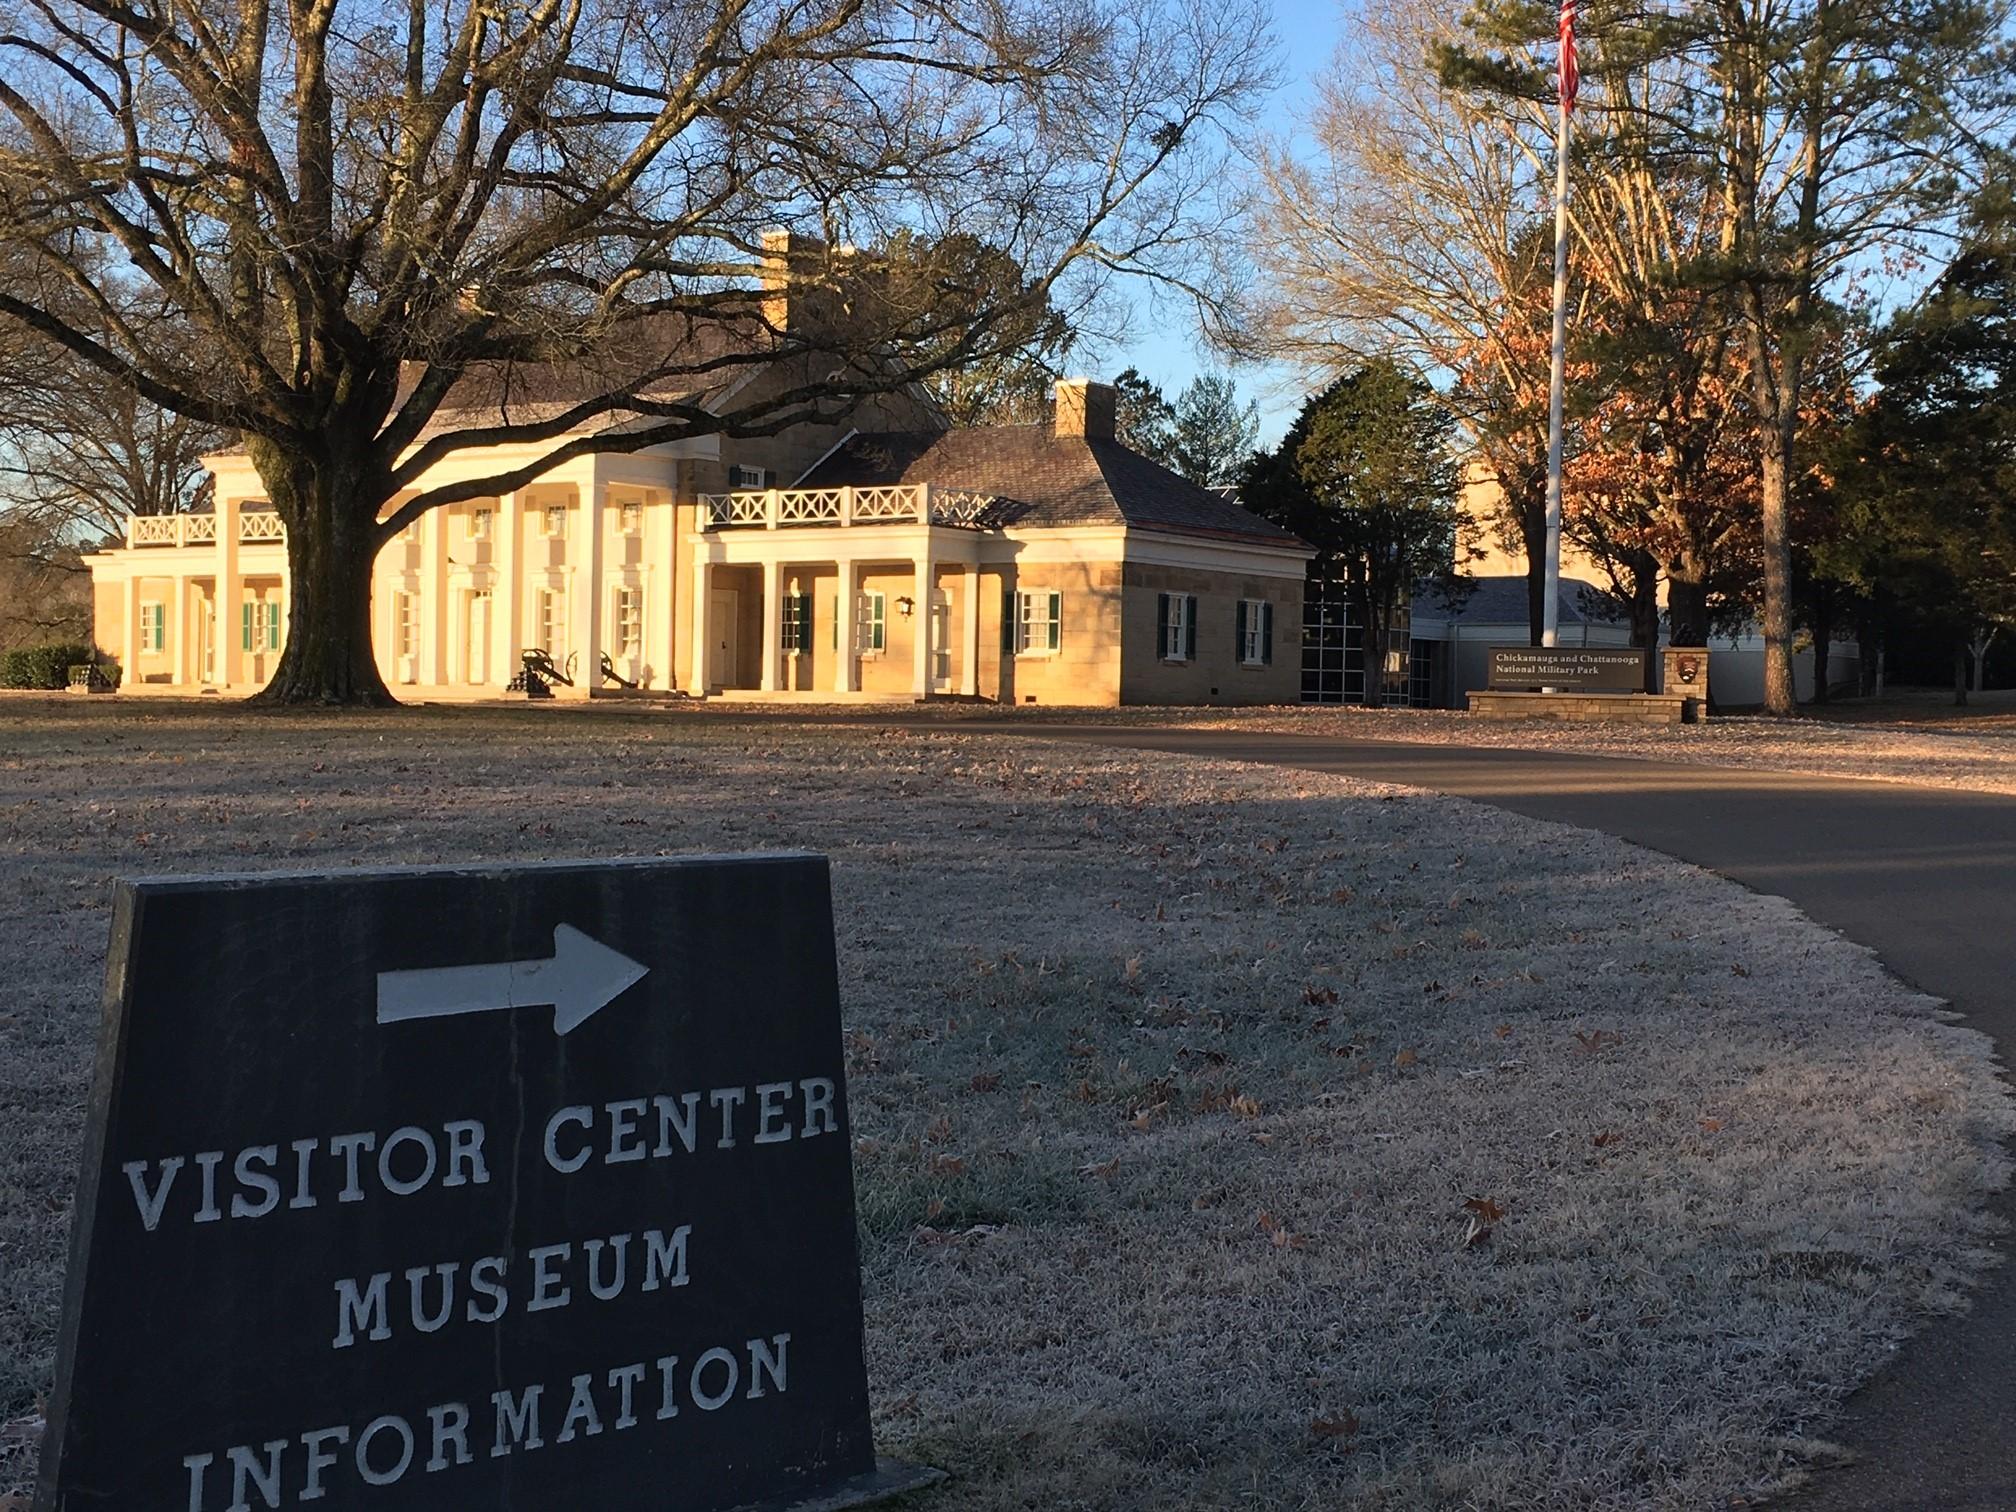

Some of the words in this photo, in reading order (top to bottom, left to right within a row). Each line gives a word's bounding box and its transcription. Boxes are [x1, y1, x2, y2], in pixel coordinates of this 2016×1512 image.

[1496, 653, 1558, 664] Chickamauga
[1560, 654, 1578, 663] and
[1580, 655, 1639, 665] Chattanooga
[1496, 665, 1536, 673] National
[1537, 665, 1574, 675] Military
[1577, 666, 1600, 674] Park
[122, 1119, 490, 1232] VISITOR
[543, 1076, 840, 1174] CENTER
[332, 1224, 693, 1349] MUSEUM
[183, 1332, 793, 1512] INFORMATION
